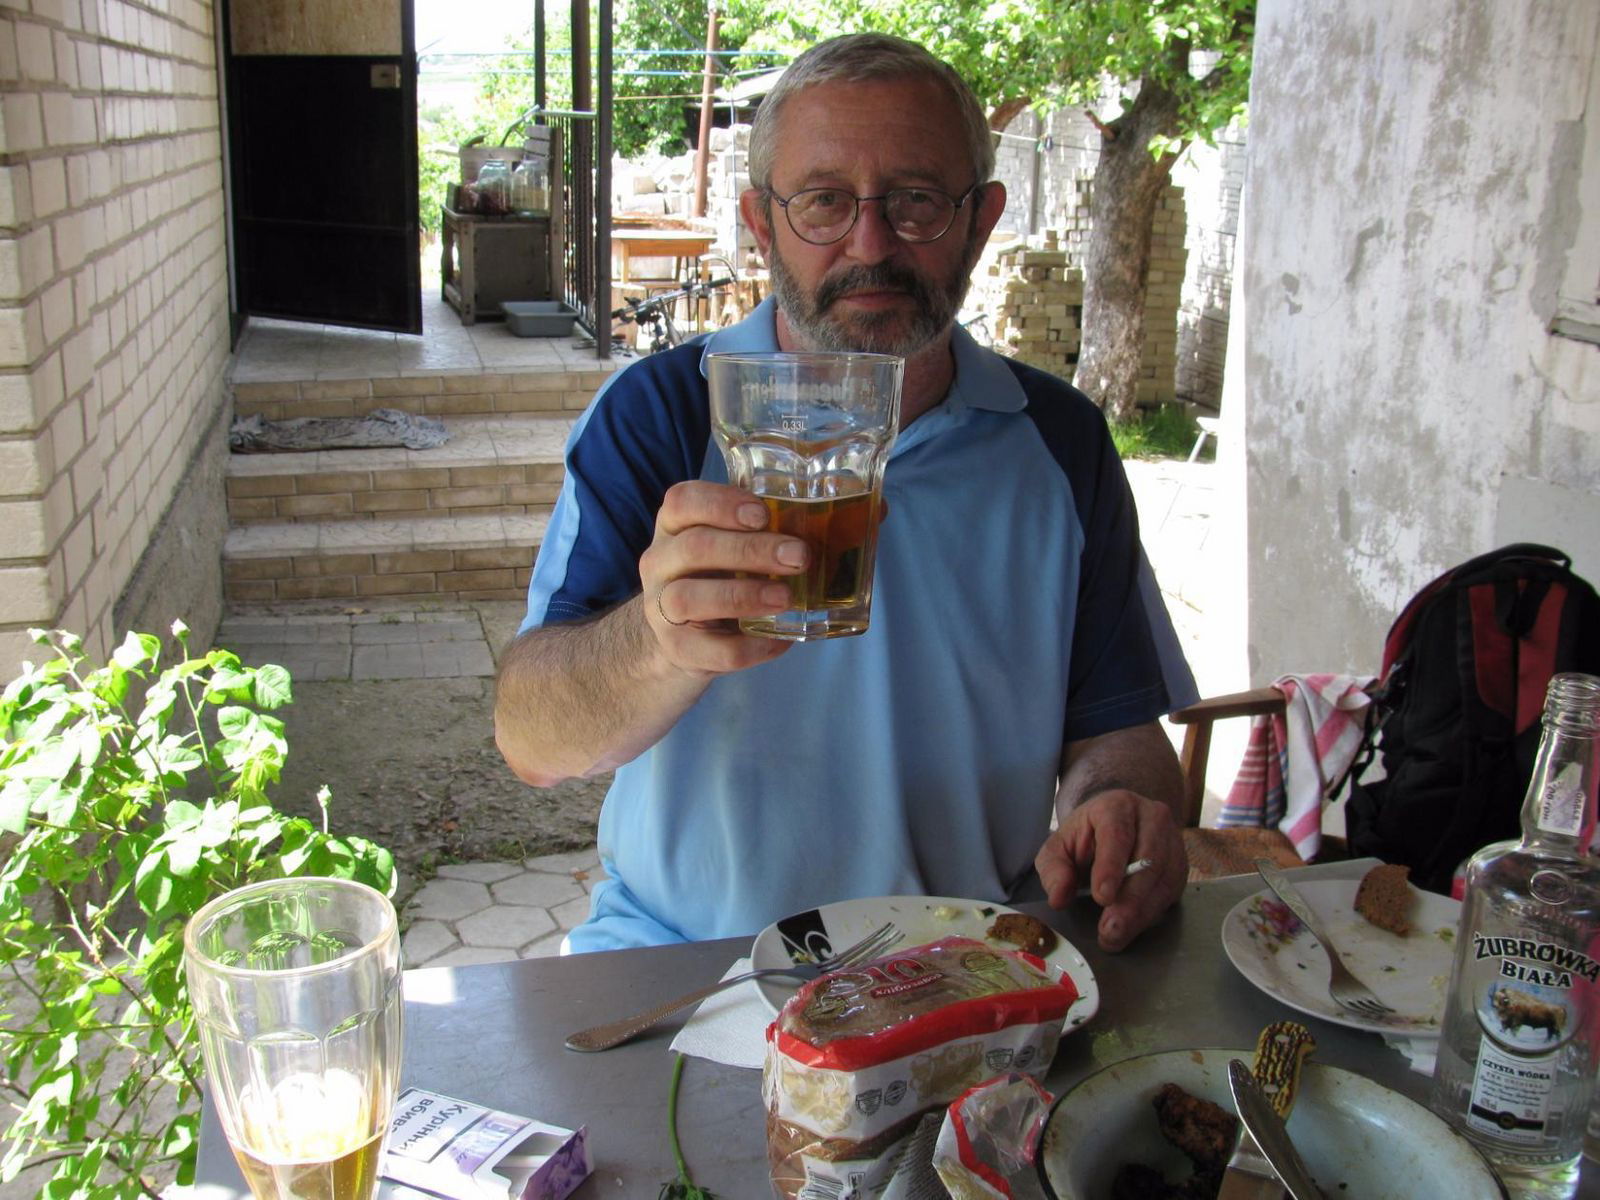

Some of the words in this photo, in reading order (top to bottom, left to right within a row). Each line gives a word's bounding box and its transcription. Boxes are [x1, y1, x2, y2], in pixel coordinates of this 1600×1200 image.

[1474, 932, 1600, 983] ŻUBRÓWKA
[1501, 960, 1572, 988] BIAŁA
[1482, 1058, 1515, 1075] CZYSTA
